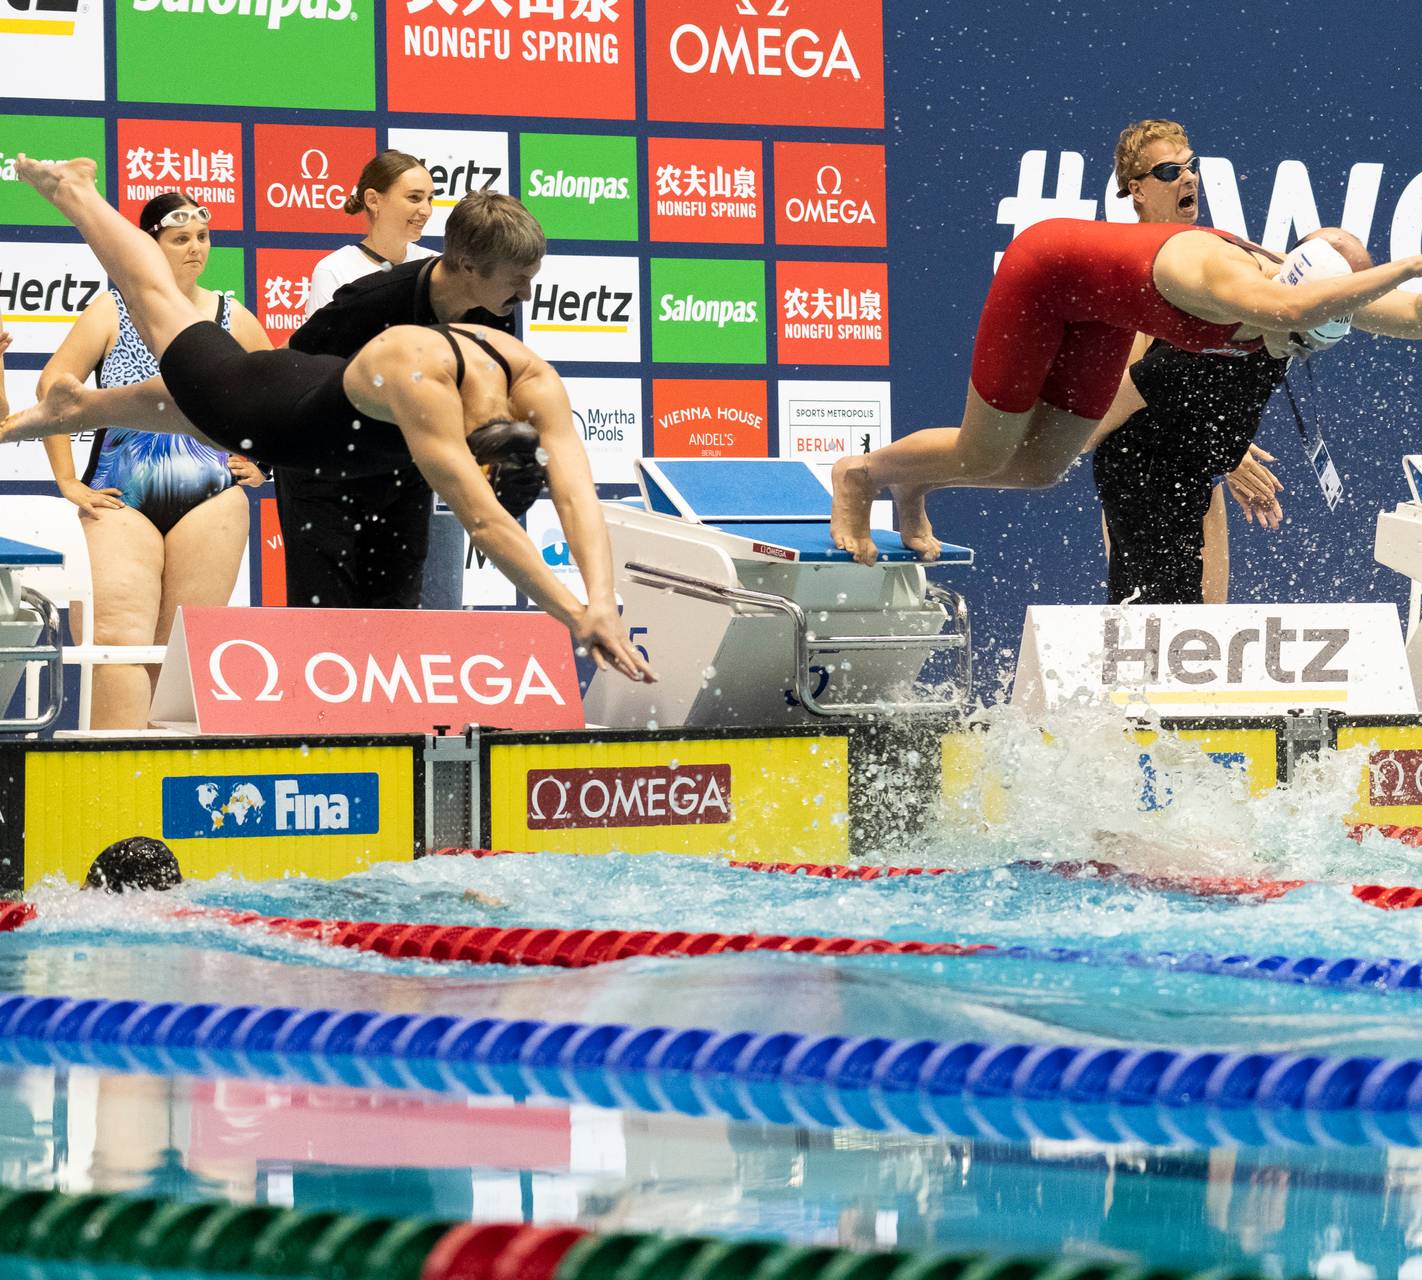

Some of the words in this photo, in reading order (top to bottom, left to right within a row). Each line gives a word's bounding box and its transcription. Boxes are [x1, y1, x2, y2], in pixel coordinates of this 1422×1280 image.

[403, 25, 511, 60] NONGFU
[521, 30, 619, 65] SPRING
[669, 23, 861, 79] OMEGA
[126, 147, 236, 183] 农夫山泉
[420, 158, 501, 196] ertz
[656, 164, 757, 200] 农夫山泉
[528, 169, 628, 204] Salonpas
[656, 201, 706, 217] NONGFU
[711, 202, 757, 219] SPRING
[785, 198, 876, 225] OMEGA
[0, 272, 101, 312] Hertz
[530, 283, 634, 322] Hertz
[784, 287, 882, 322] 农夫山泉
[265, 313, 307, 330] NONG
[658, 294, 757, 328] Salonpas
[784, 323, 833, 340] NONGFU
[837, 324, 882, 341] SPRING
[588, 409, 635, 427] Myrtha
[659, 407, 712, 429] VIENNA
[717, 407, 763, 430] HOUSE
[796, 409, 825, 418] SPORTS
[827, 408, 874, 419] METROPOLIS
[588, 426, 624, 441] Pools
[797, 438, 845, 452] BERLIN
[1101, 616, 1350, 685] Hertz
[304, 651, 566, 705] OMEGA
[275, 780, 350, 830] Fina
[579, 775, 729, 818] OMEGA
